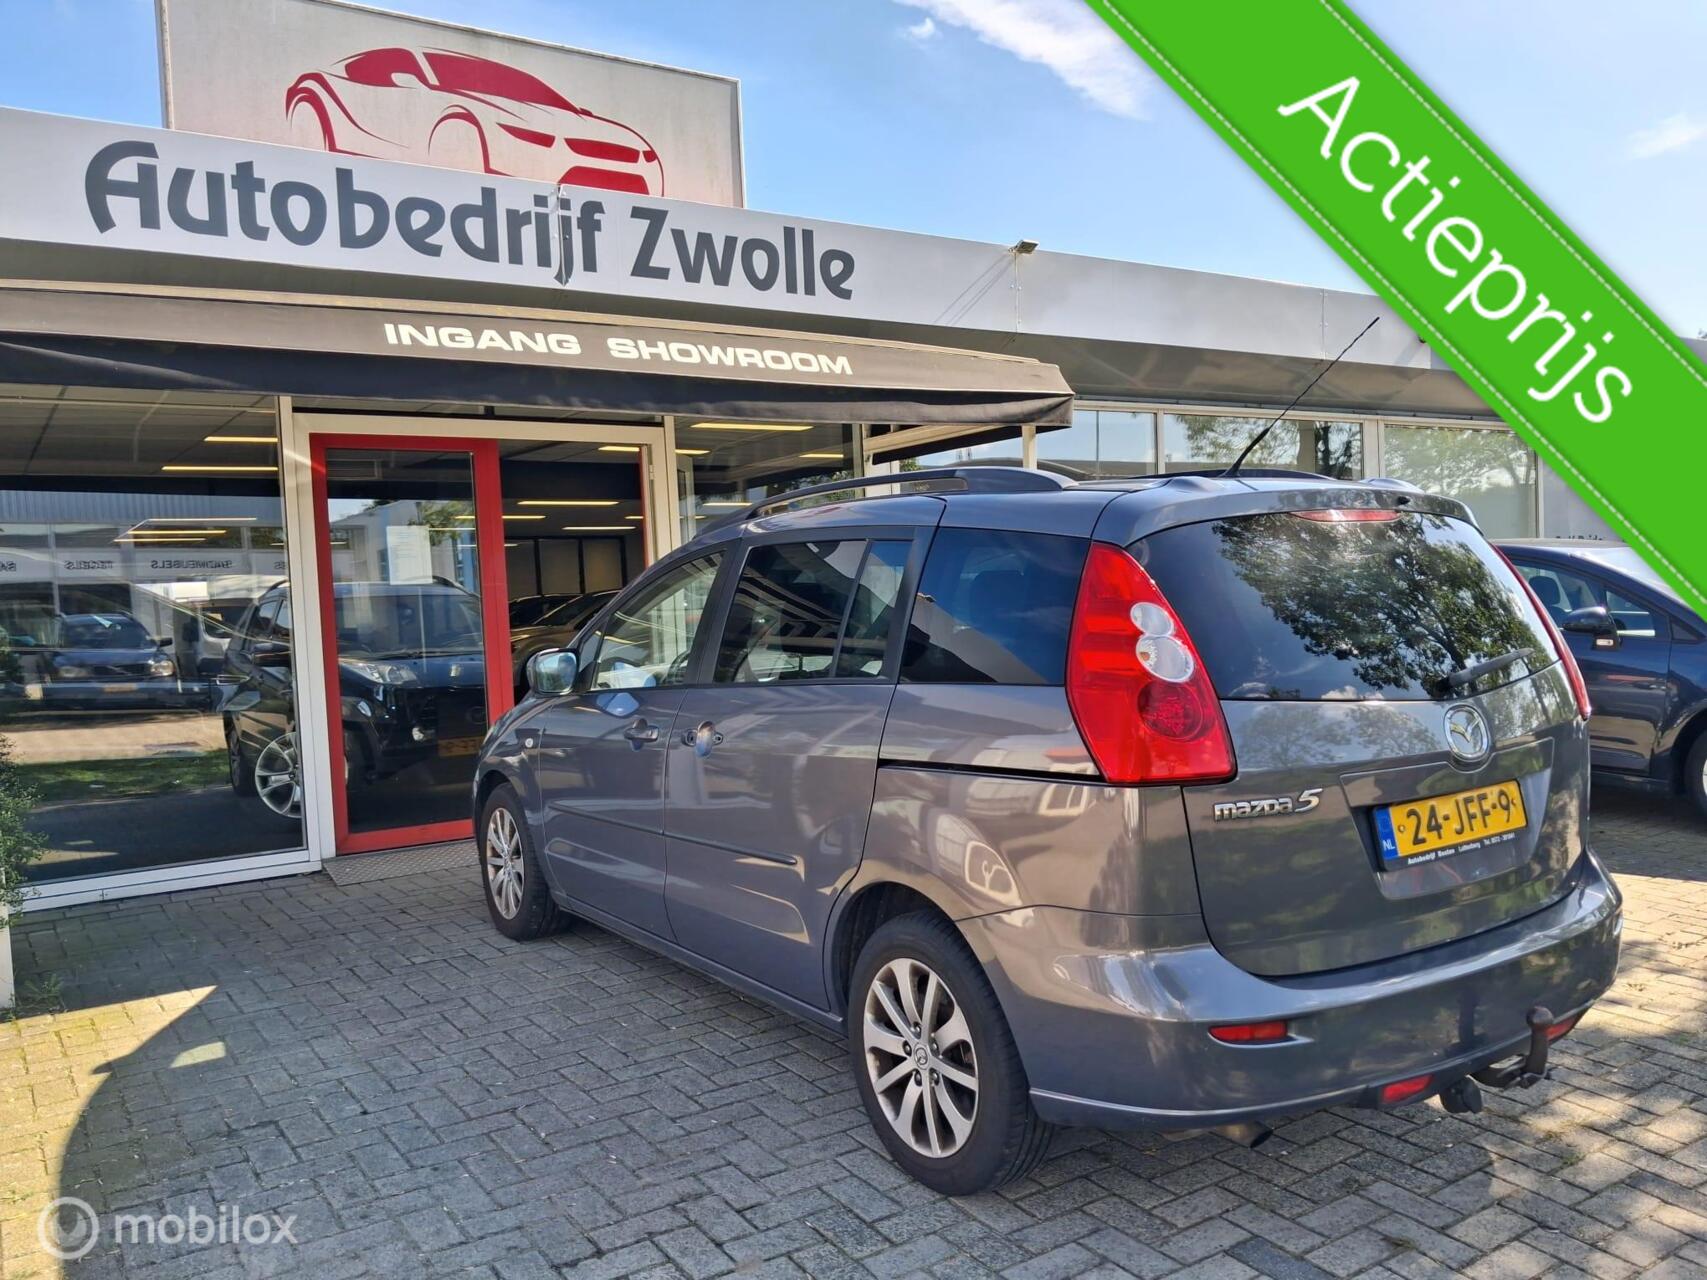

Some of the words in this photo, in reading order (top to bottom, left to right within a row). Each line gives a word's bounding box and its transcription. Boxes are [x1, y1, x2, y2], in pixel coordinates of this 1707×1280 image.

[85, 140, 605, 286] Autobedrijf
[630, 206, 856, 301] Zwolle
[385, 322, 582, 357] INGANG
[608, 337, 854, 376] SHOWROOM
[1382, 838, 1396, 852] NL
[1406, 789, 1513, 846] 24-JFF-9
